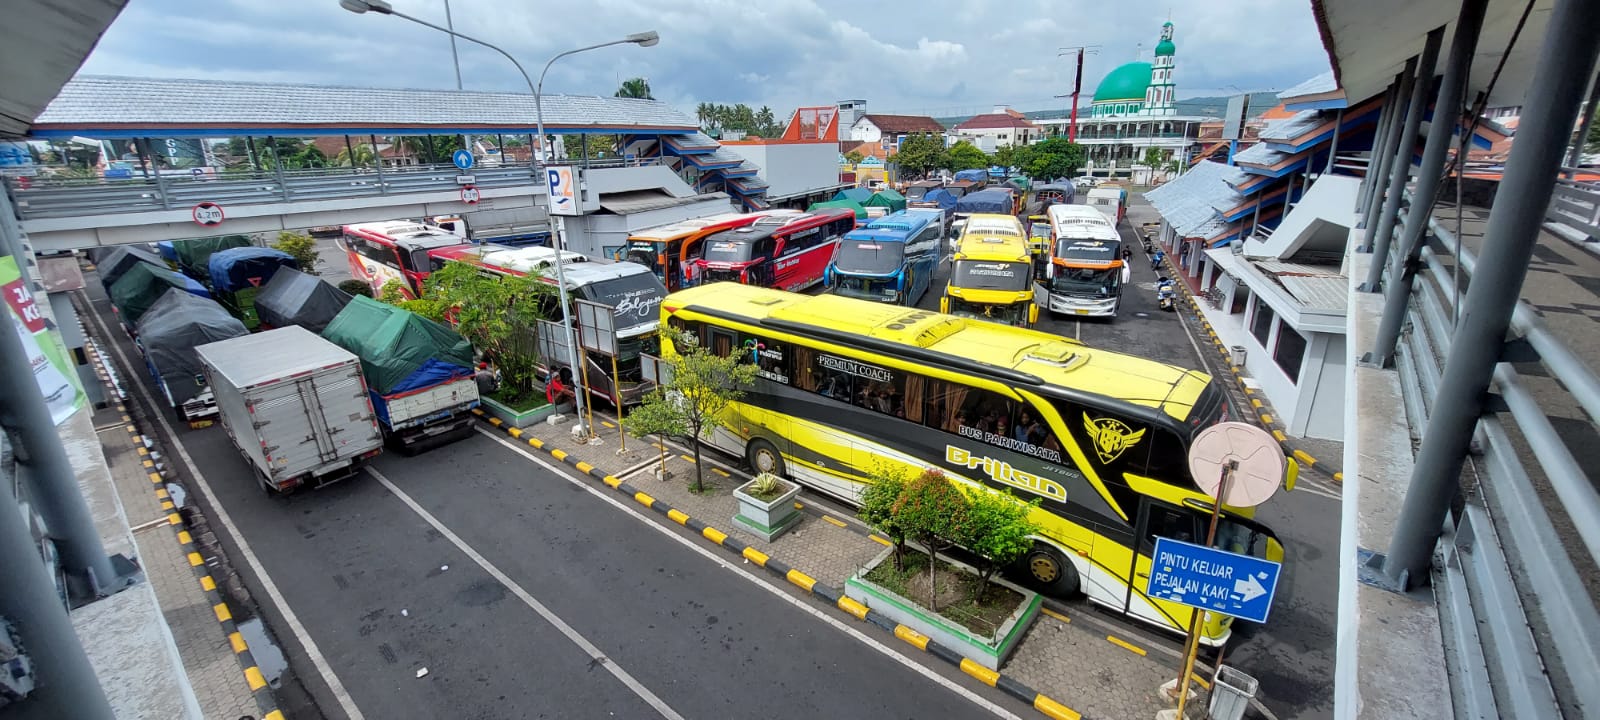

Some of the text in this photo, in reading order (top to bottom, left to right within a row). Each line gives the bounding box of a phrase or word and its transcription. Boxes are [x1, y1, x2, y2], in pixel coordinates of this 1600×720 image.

[819, 355, 891, 381] PREMIUM COACH
[958, 425, 1062, 463] BUS PARIWISATA
[1160, 551, 1234, 580] PINTU KELUAR
[1154, 572, 1229, 601] PEJALAN KAKI
